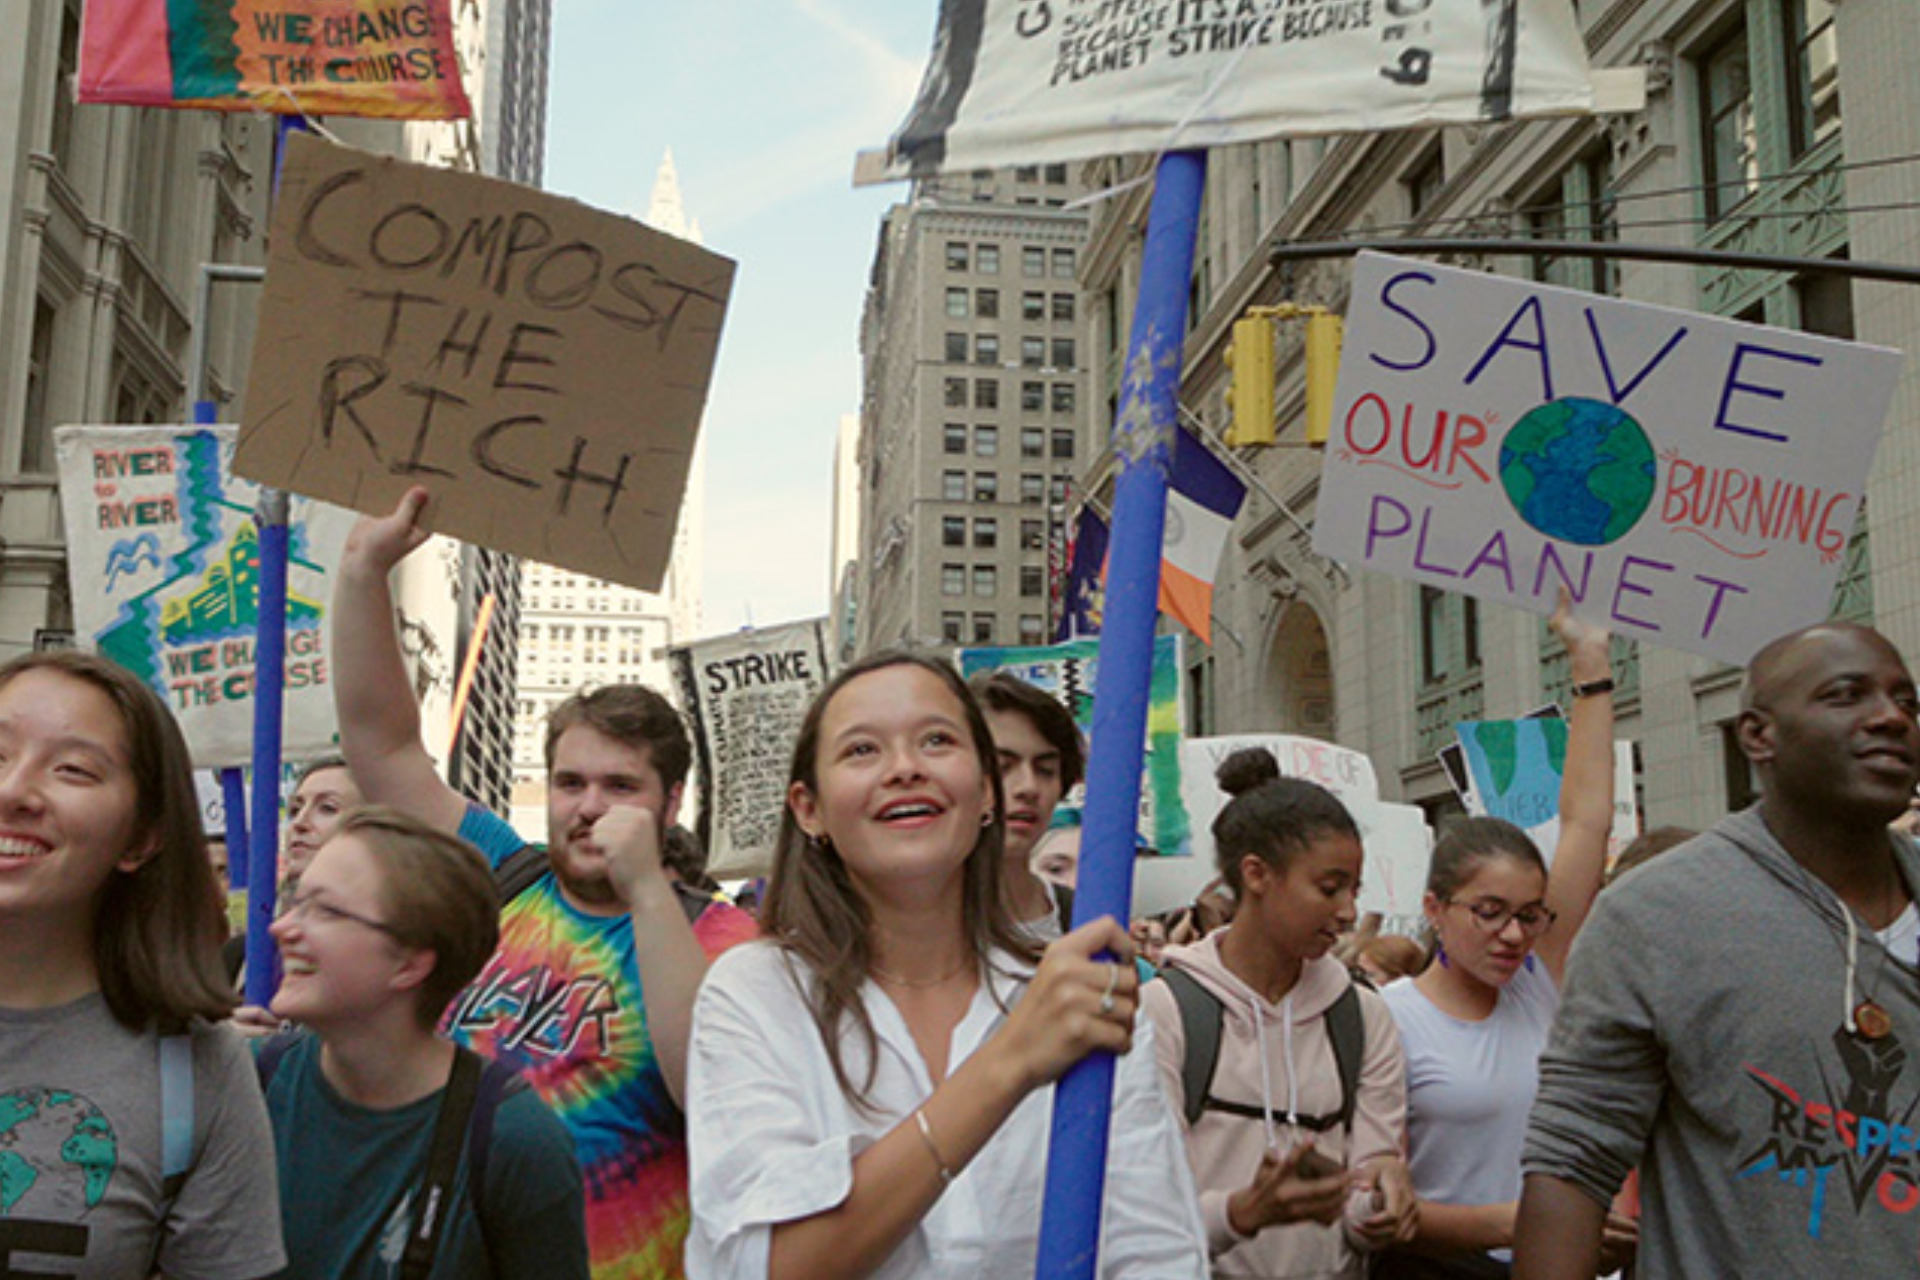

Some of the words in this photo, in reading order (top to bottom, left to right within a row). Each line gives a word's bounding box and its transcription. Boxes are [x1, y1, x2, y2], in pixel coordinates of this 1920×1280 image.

[253, 12, 314, 45] WE
[1051, 38, 1152, 86] PLANET
[1168, 15, 1274, 57] STRIKE
[1282, 1, 1372, 43] BECAUSE
[1058, 6, 1169, 58] BECAUSE
[261, 54, 317, 85] THE
[324, 48, 446, 83] COURSE
[295, 169, 726, 352] COMPOST
[347, 286, 566, 395] THE
[1368, 271, 1824, 443] SAVE
[93, 446, 174, 479] RIVER
[319, 354, 636, 527] RICH
[1344, 392, 1491, 483] OUR
[1661, 457, 1850, 553] BURNING
[97, 494, 180, 530] RIVER
[1364, 494, 1749, 639] PLANET
[168, 643, 219, 677] WE
[222, 629, 323, 669] CHGE
[170, 675, 222, 709] THE
[222, 657, 328, 700] CSE
[705, 651, 812, 694] STRIKE
[1743, 1061, 1920, 1158] RESPE
